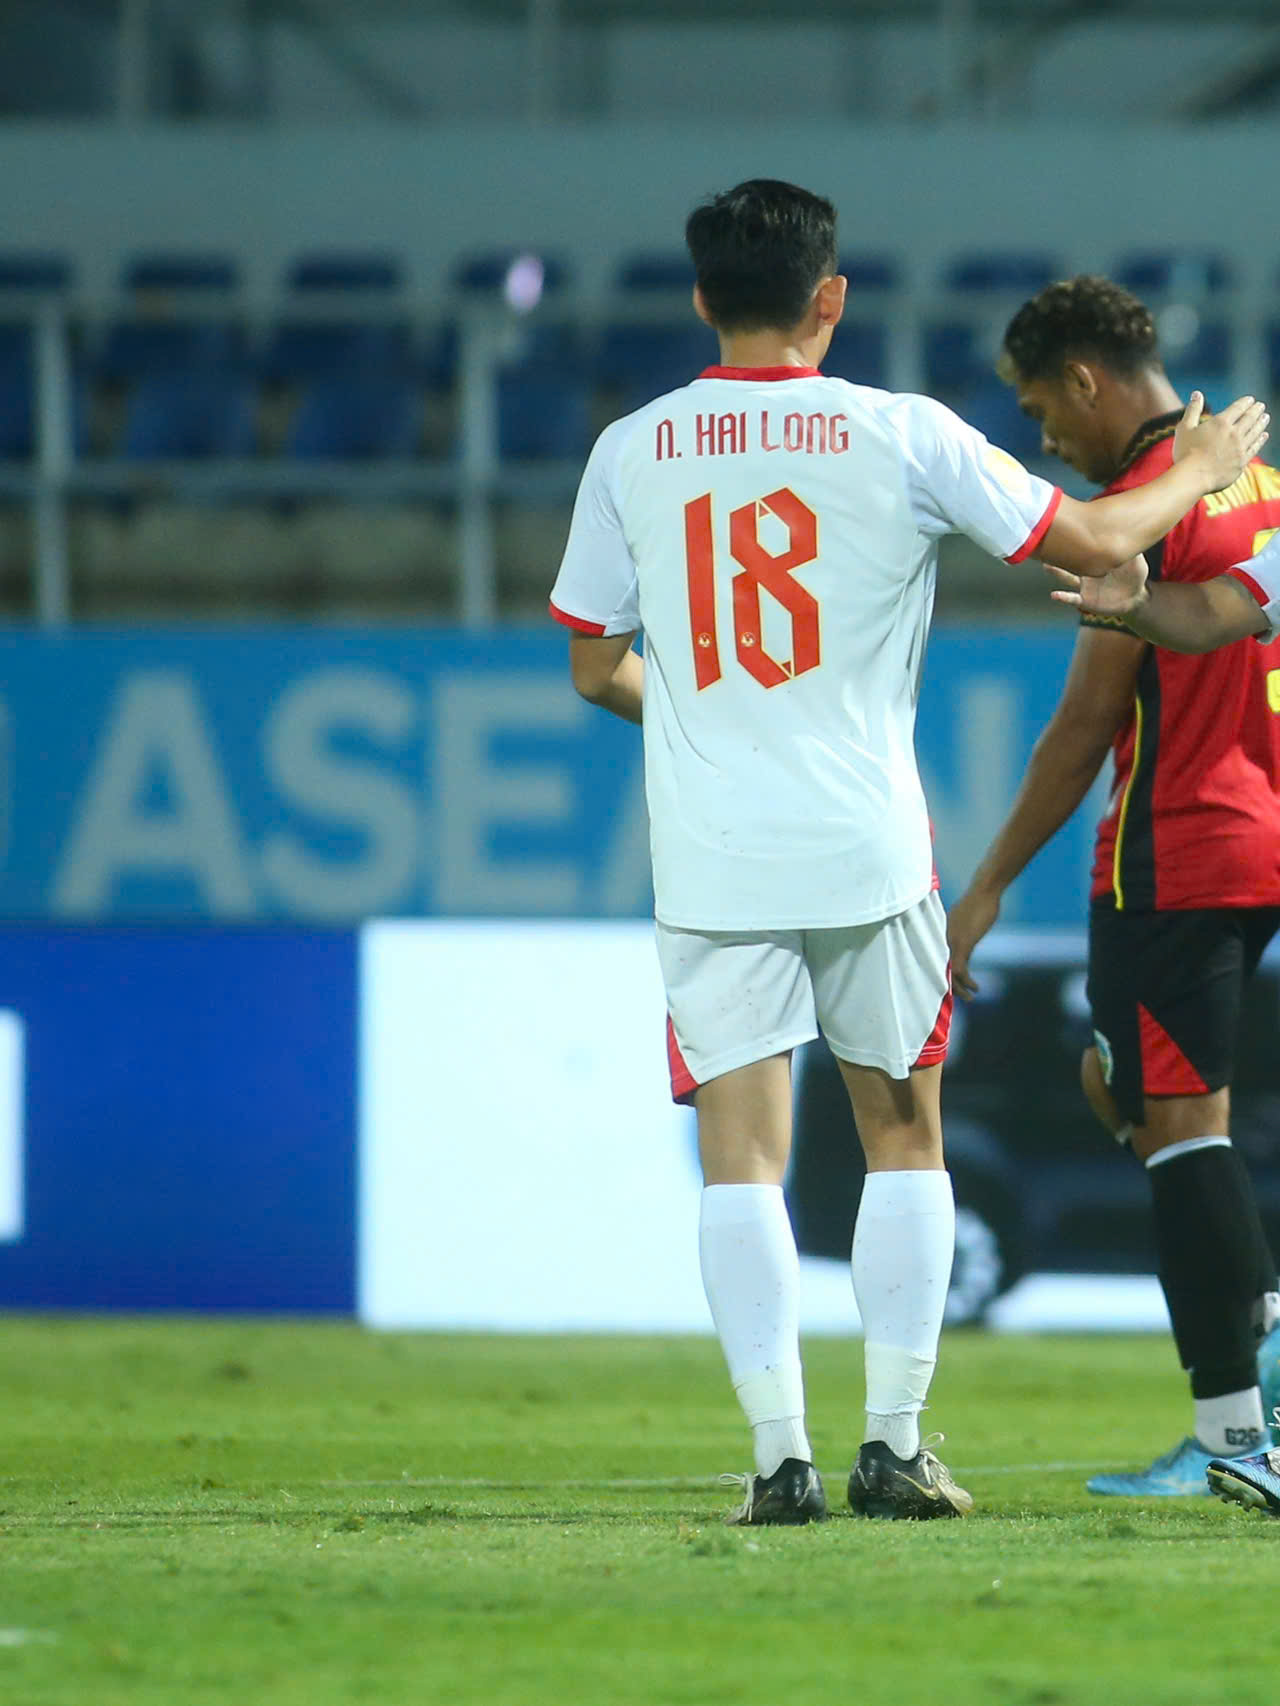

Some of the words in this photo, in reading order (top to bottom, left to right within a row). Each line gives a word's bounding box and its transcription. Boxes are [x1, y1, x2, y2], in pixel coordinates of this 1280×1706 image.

[695, 411, 748, 457] HAI
[760, 410, 850, 455] LONG
[684, 486, 821, 692] 18
